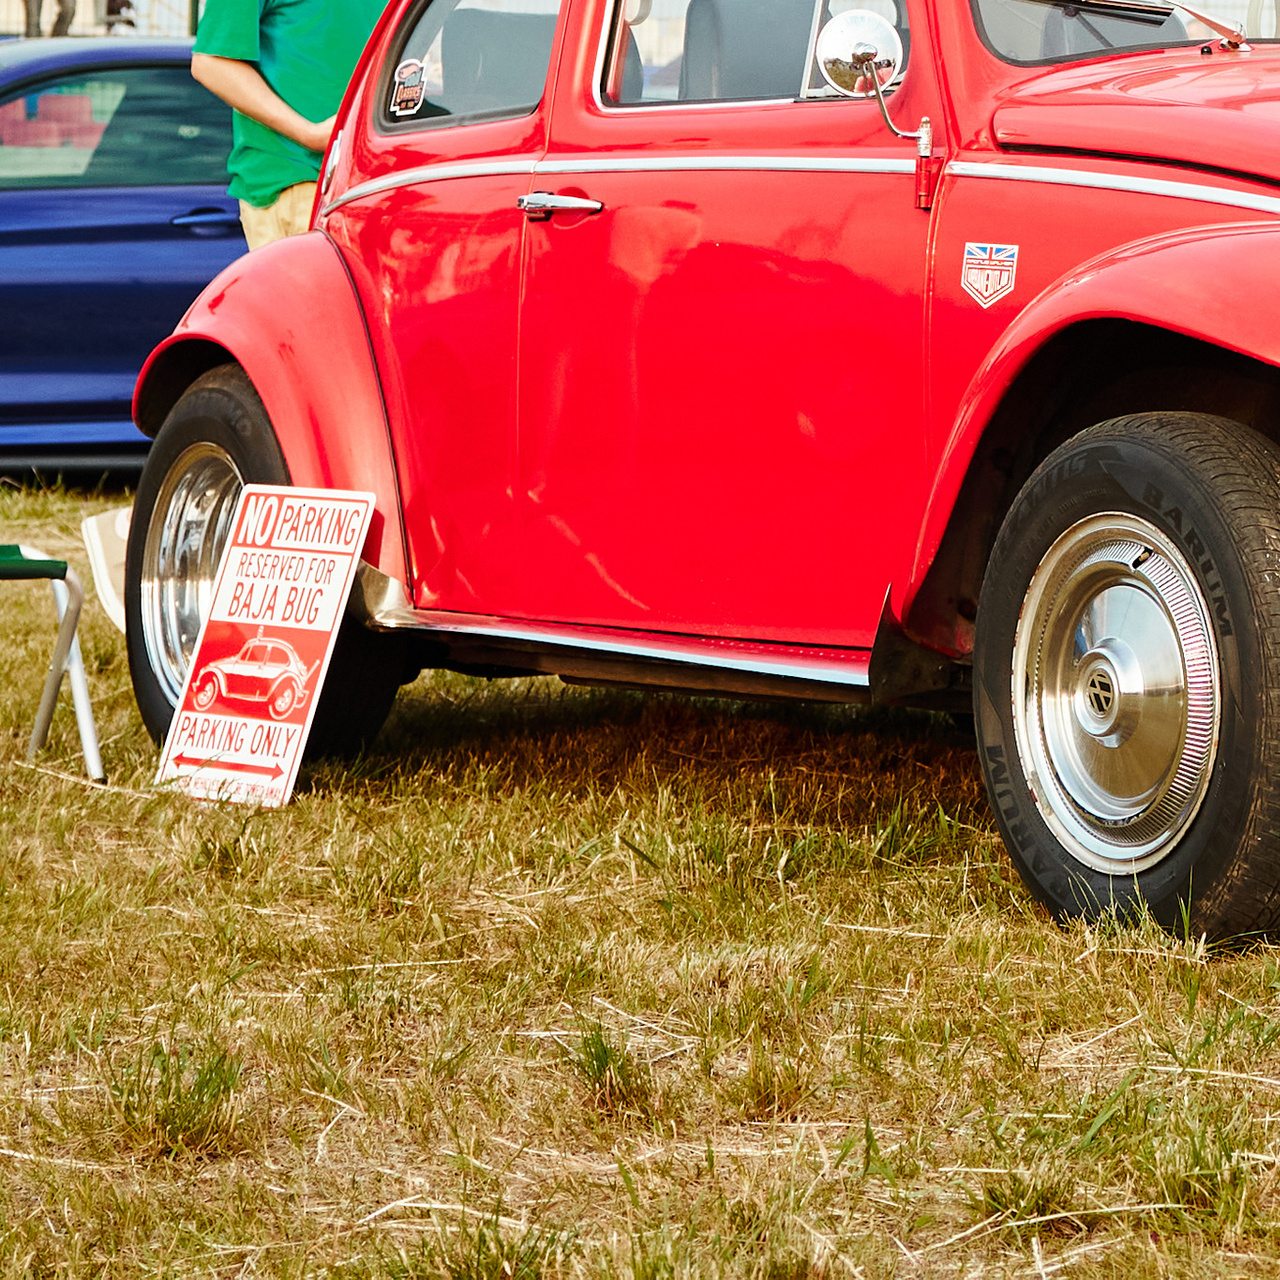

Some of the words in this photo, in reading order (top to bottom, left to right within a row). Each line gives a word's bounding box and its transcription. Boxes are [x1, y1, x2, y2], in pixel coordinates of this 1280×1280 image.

[237, 495, 279, 546] NO
[277, 505, 360, 546] PARKING
[236, 552, 305, 582] RESERVED
[305, 557, 336, 585] FOR
[1142, 482, 1233, 637] BARUM
[227, 581, 279, 621] BAJA
[281, 586, 323, 625] BUG
[177, 716, 247, 752] PARKING
[250, 724, 297, 758] ONLY
